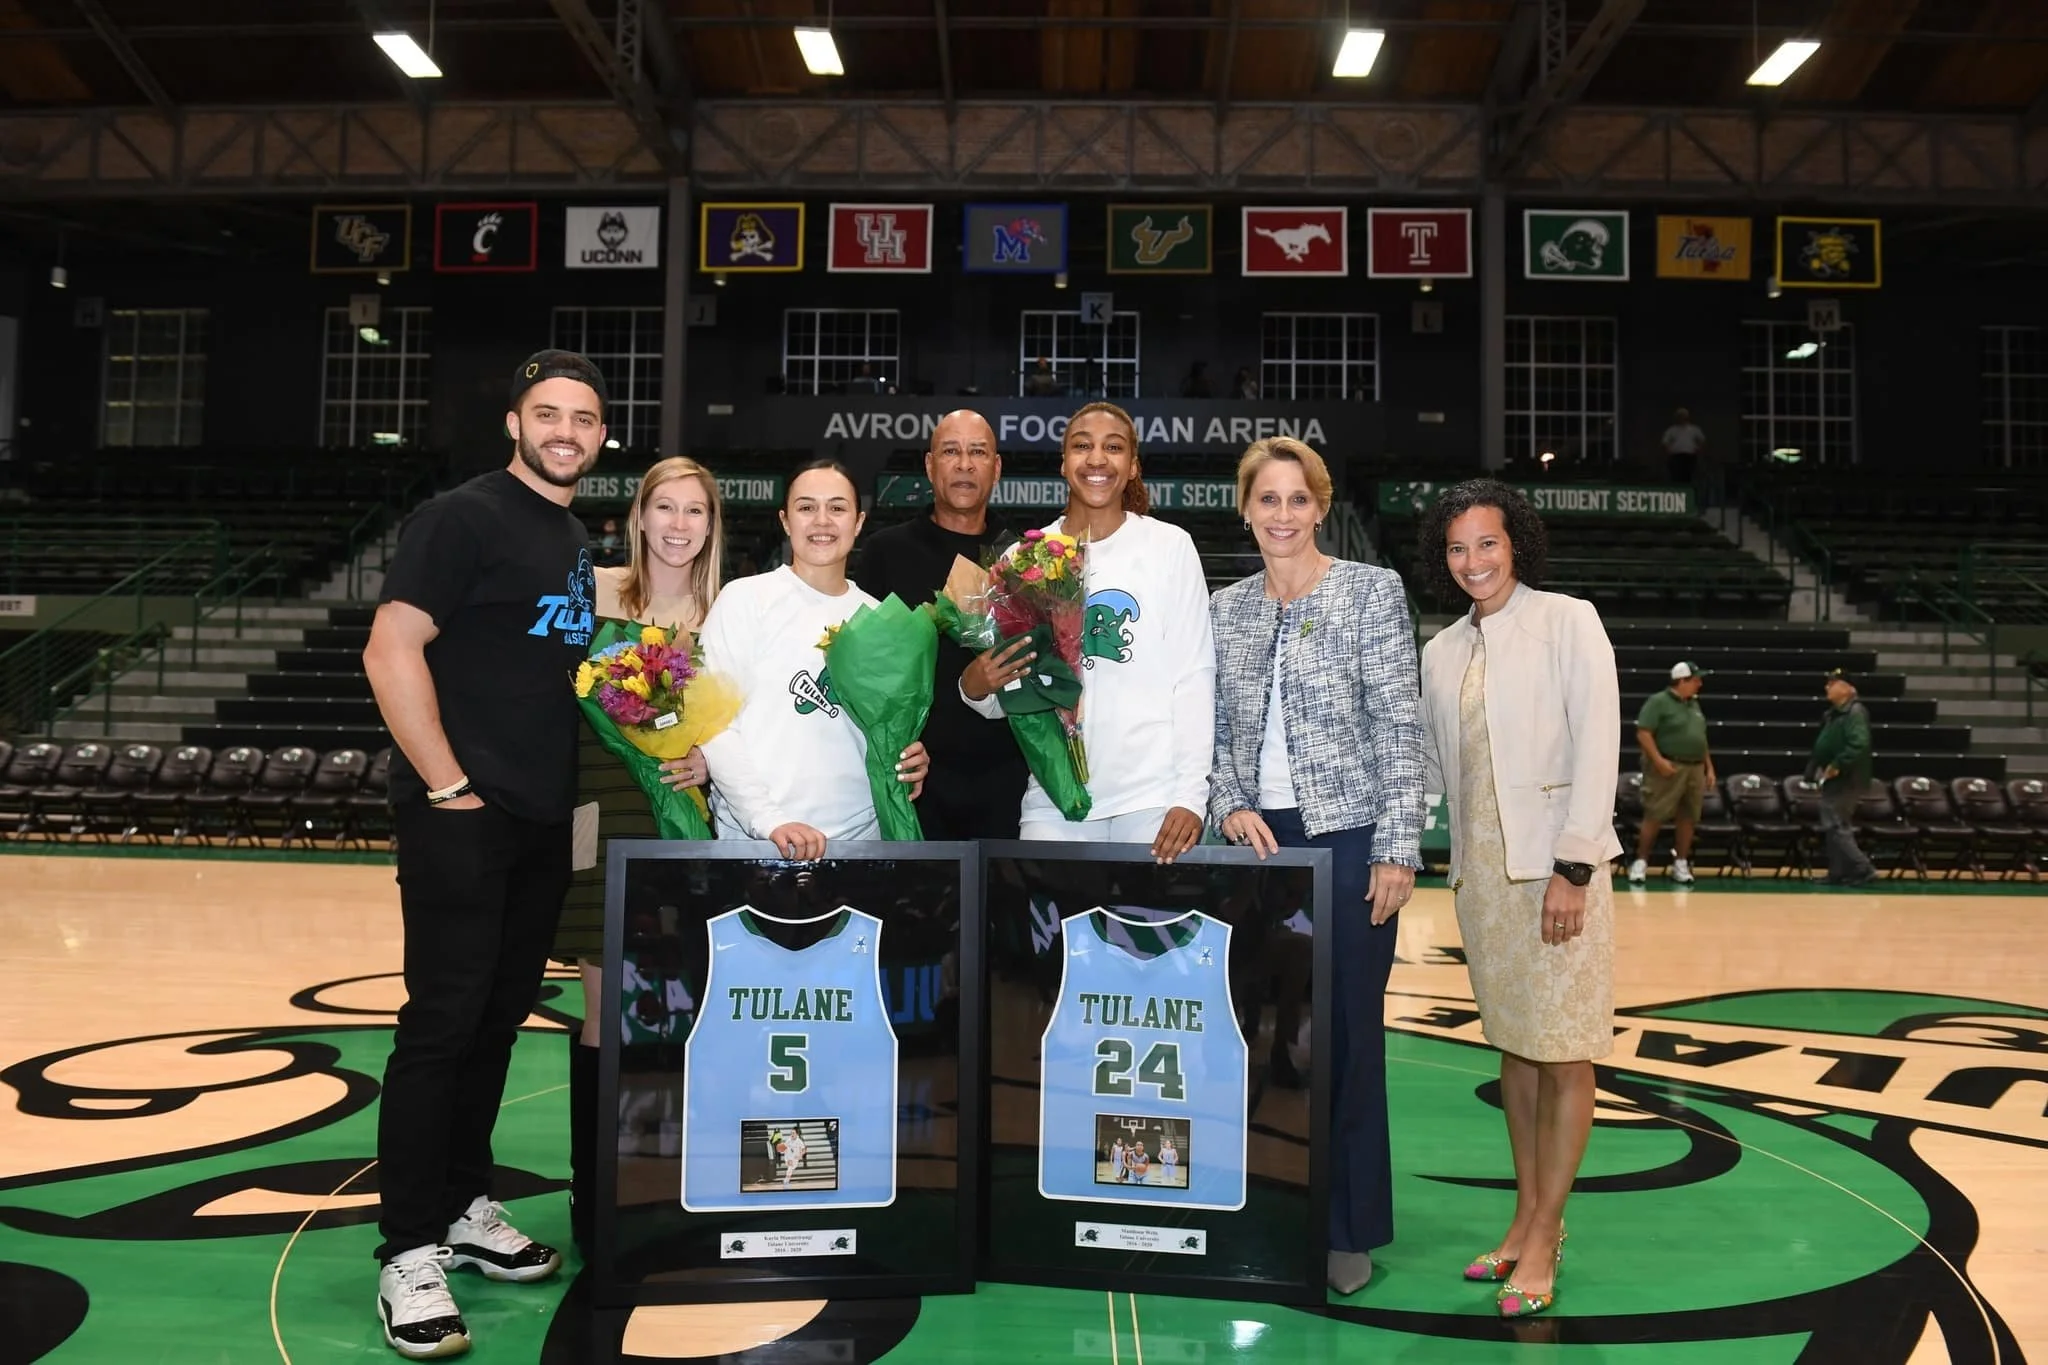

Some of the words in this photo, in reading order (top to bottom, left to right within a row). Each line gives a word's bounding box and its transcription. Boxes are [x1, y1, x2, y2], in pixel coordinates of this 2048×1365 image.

[333, 215, 391, 263] UCF
[993, 225, 1030, 263] M
[1401, 221, 1438, 265] T
[1674, 235, 1737, 261] Tulsa
[581, 249, 643, 264] UCONN
[1090, 302, 1104, 320] K
[1813, 309, 1835, 327] M
[824, 412, 940, 440] AVRON
[1203, 416, 1327, 445] ARENA
[577, 477, 619, 497] DERS
[714, 479, 774, 501] ECTION
[1182, 481, 1238, 508] SECTI
[1533, 489, 1611, 512] STUDENT
[1616, 490, 1687, 513] SECTION
[527, 594, 593, 637] TULA
[799, 678, 828, 709] TULANE
[728, 986, 854, 1023] TULANE
[1078, 992, 1205, 1033] TULANE
[767, 1032, 809, 1094] 5
[1092, 1037, 1187, 1102] 24
